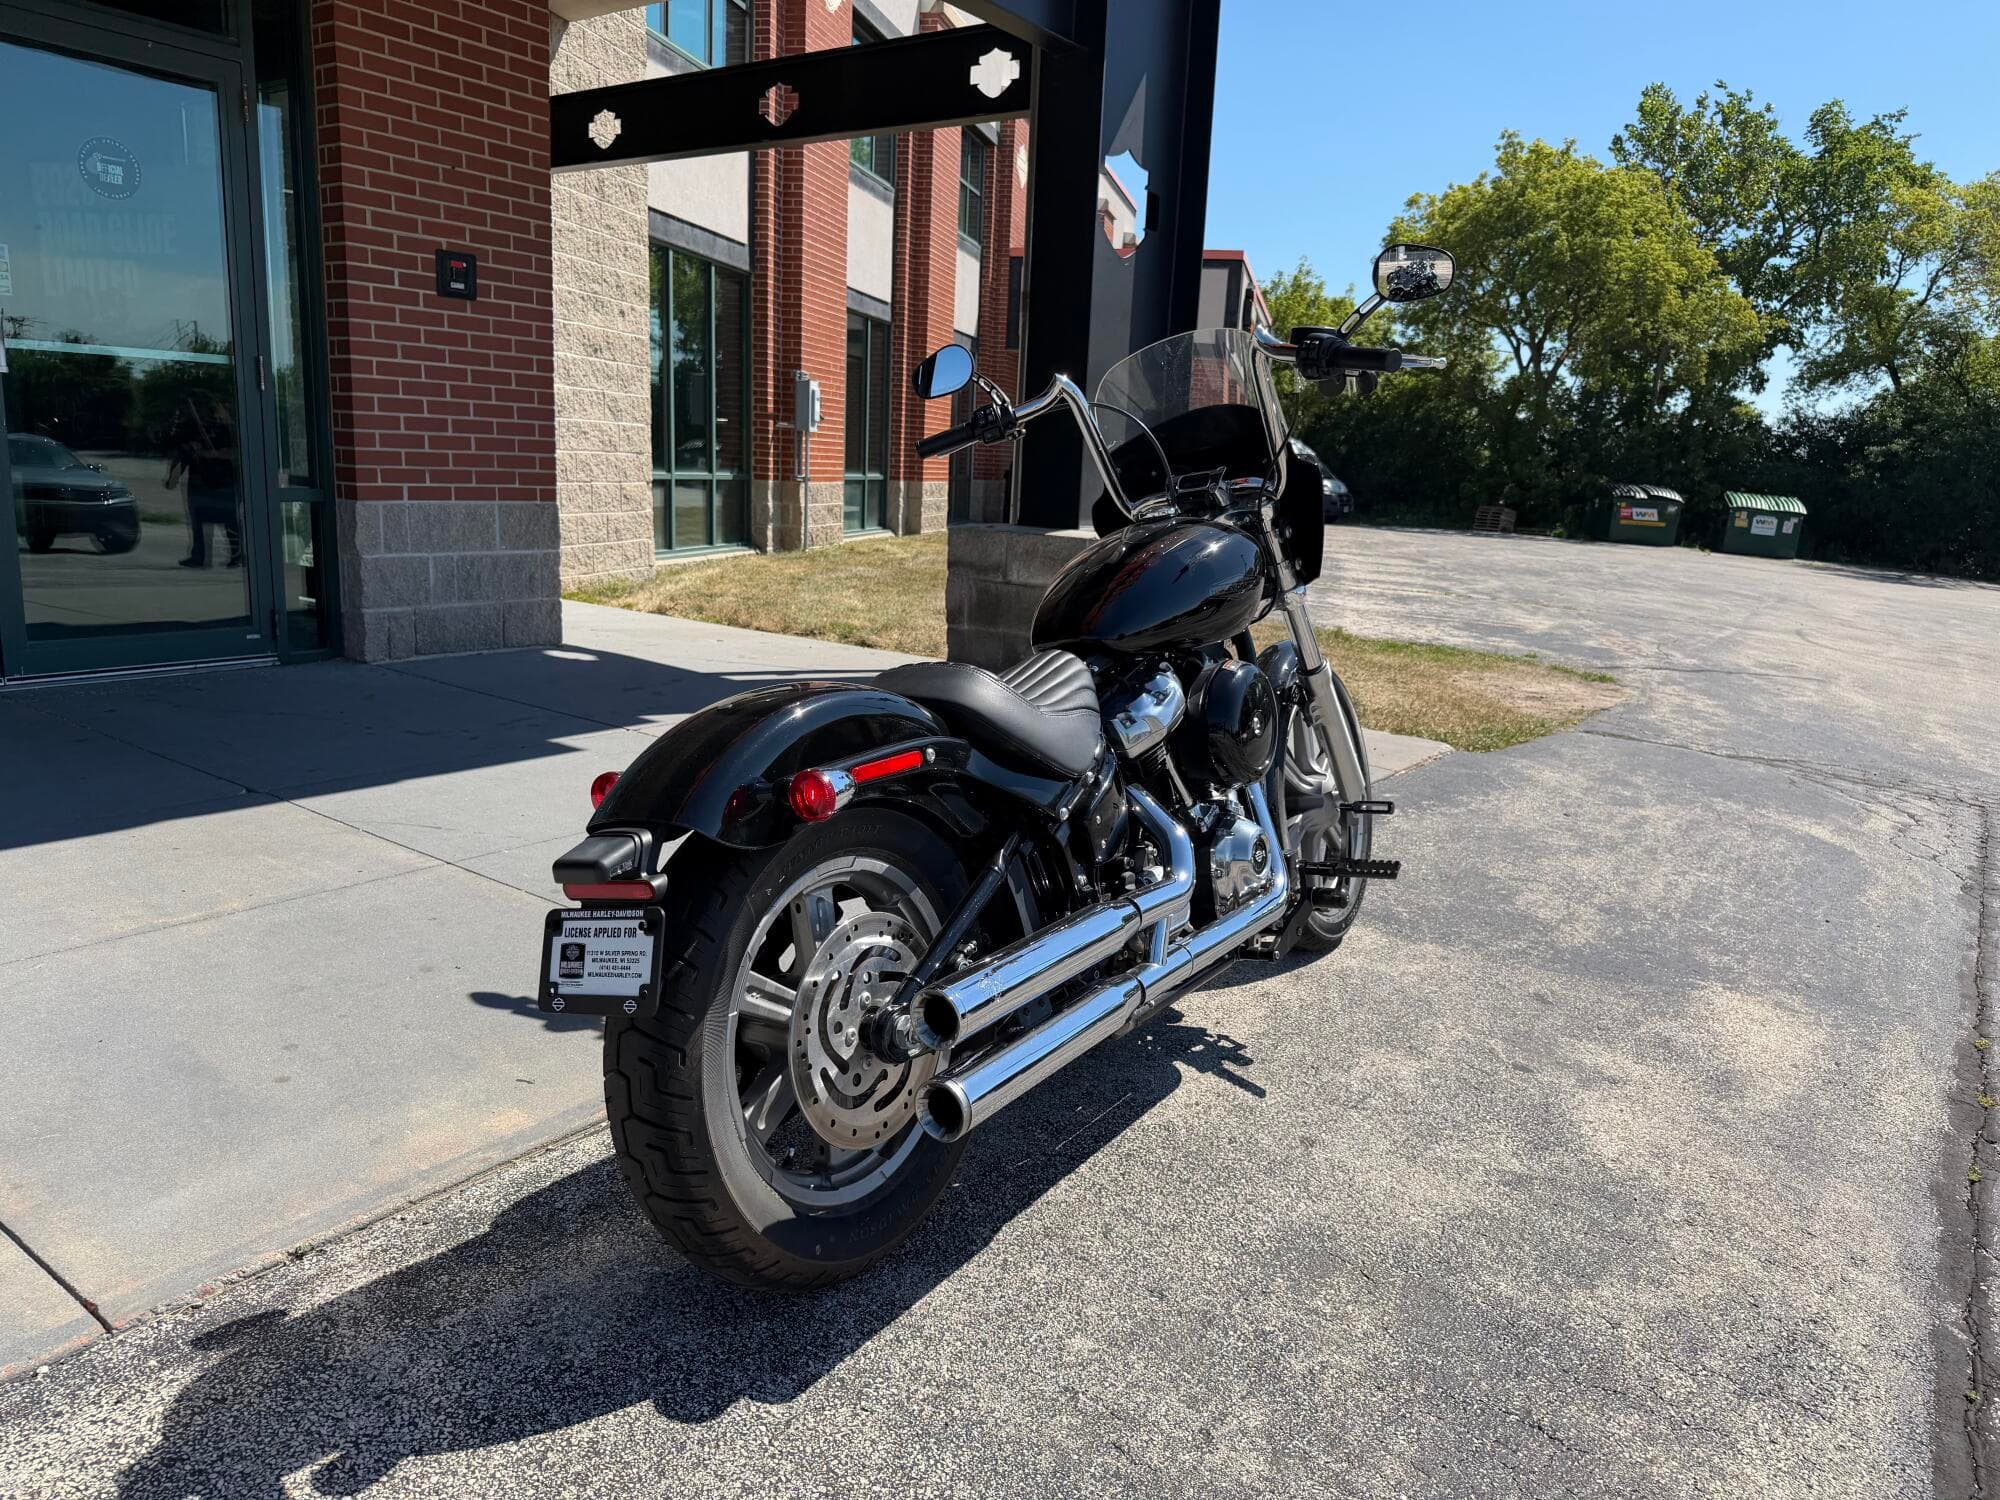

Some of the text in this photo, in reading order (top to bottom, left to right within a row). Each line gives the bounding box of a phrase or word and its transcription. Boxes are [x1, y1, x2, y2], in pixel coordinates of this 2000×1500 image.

[592, 910, 644, 918] HARLEY-DAVIDSON
[564, 927, 638, 938] LICENSE APPLIED FOR
